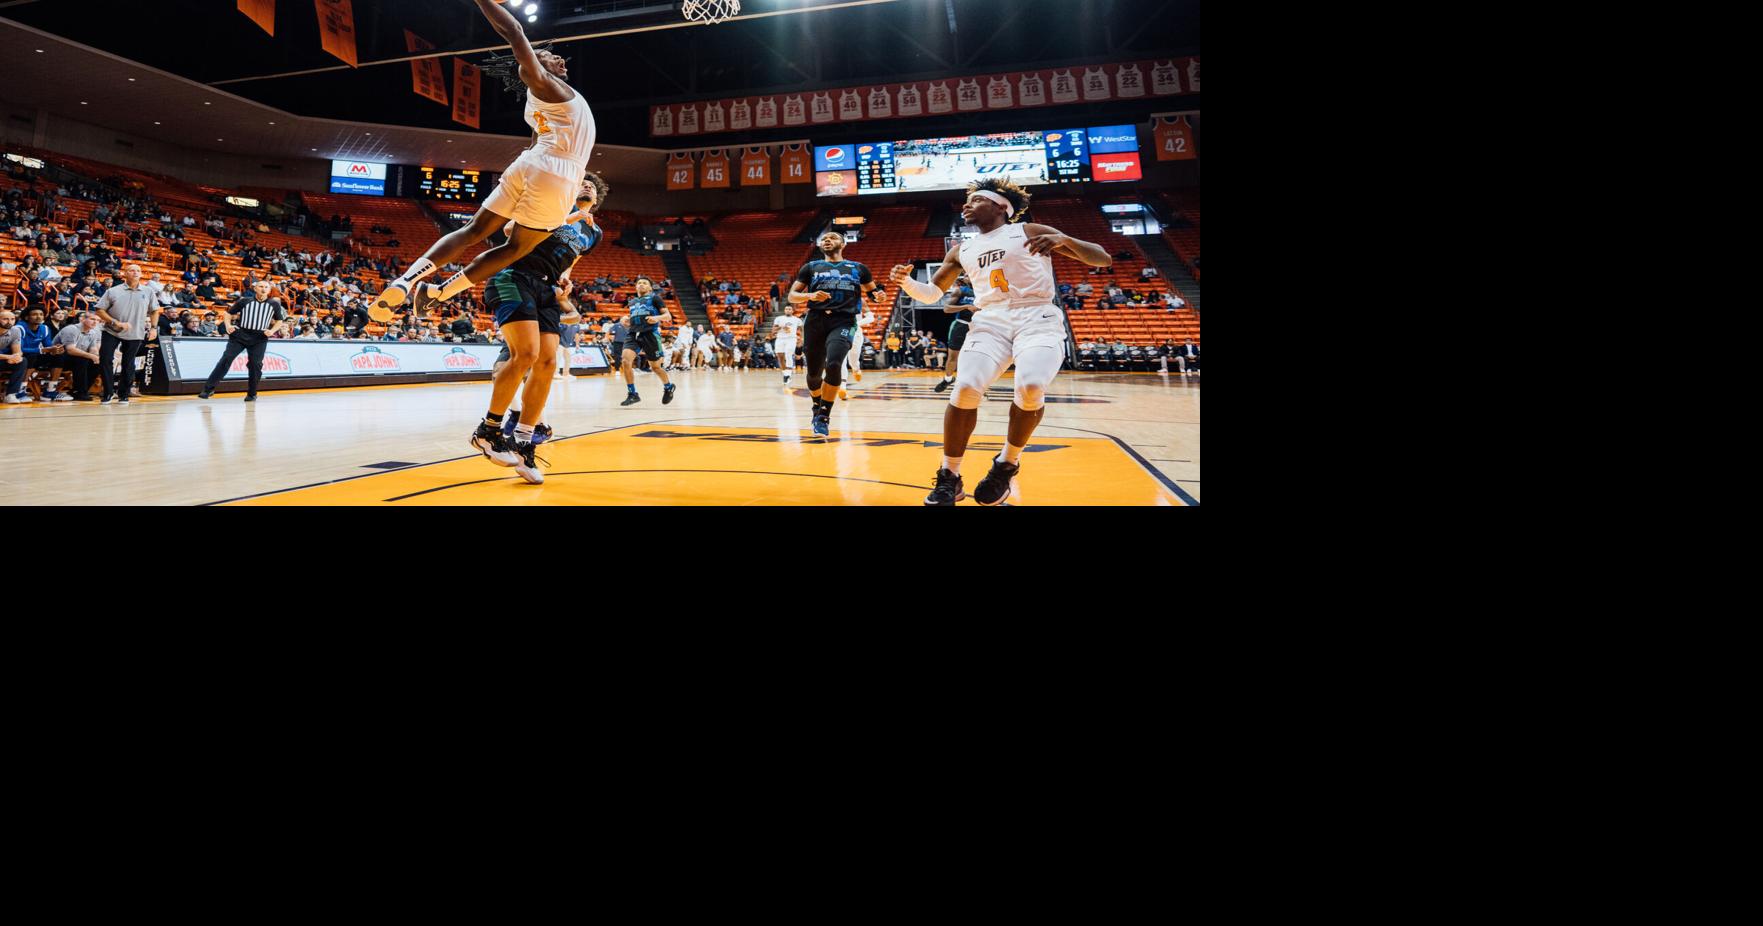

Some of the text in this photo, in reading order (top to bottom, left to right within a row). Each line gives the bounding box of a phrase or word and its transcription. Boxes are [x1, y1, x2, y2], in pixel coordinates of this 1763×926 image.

[1122, 76, 1138, 86] 22
[1158, 73, 1174, 82] 34
[1024, 85, 1039, 94] 10
[1056, 82, 1070, 91] 21
[962, 90, 976, 98] 42
[992, 88, 1006, 96] 32
[843, 101, 857, 109] 40
[872, 99, 886, 107] 44
[902, 96, 917, 105] 50
[1165, 138, 1186, 152] 42
[1052, 149, 1060, 158] 6
[1073, 147, 1082, 156] 6
[977, 162, 1042, 174] UTEP
[1056, 160, 1080, 169] 16:25
[747, 166, 764, 179] 44
[789, 163, 802, 177] 14
[425, 172, 433, 180] 6
[672, 170, 688, 184] 42
[706, 168, 723, 182] 45
[440, 180, 461, 189] 16:25
[977, 248, 1006, 269] UTEP
[989, 268, 1009, 293] 4
[352, 355, 373, 369] PAPA
